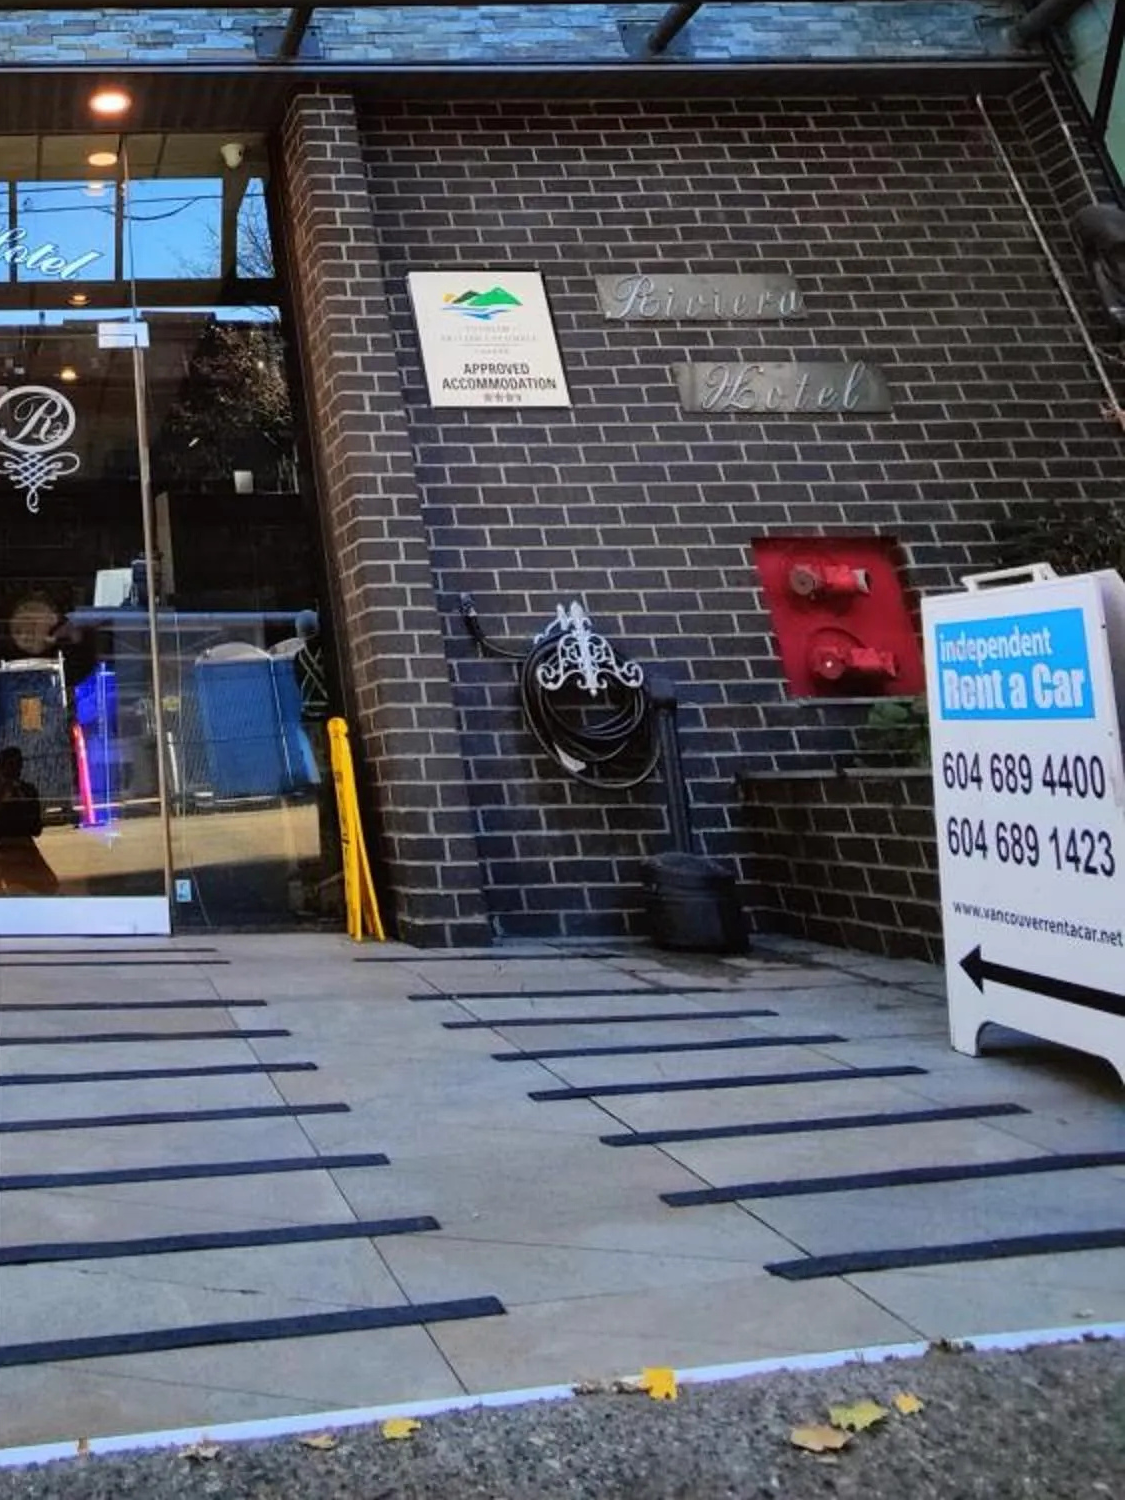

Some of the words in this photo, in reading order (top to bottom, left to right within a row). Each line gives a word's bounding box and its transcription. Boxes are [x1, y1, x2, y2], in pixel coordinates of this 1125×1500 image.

[604, 275, 800, 319] Riviera
[442, 377, 557, 390] ACCOMMODATION
[463, 363, 530, 375] APPROVED
[701, 360, 867, 411] Hotel
[940, 625, 1054, 668] independent
[942, 669, 1006, 710] Rent
[1009, 672, 1028, 709] a
[1032, 662, 1085, 709] Car
[943, 752, 984, 792] 604
[990, 753, 1033, 796] 689
[1042, 754, 1106, 800] 4400
[947, 816, 988, 861] 604
[996, 821, 1041, 868] 689
[1049, 825, 1116, 878] 1423
[952, 901, 1124, 949] www.vancouverrentacar.net
